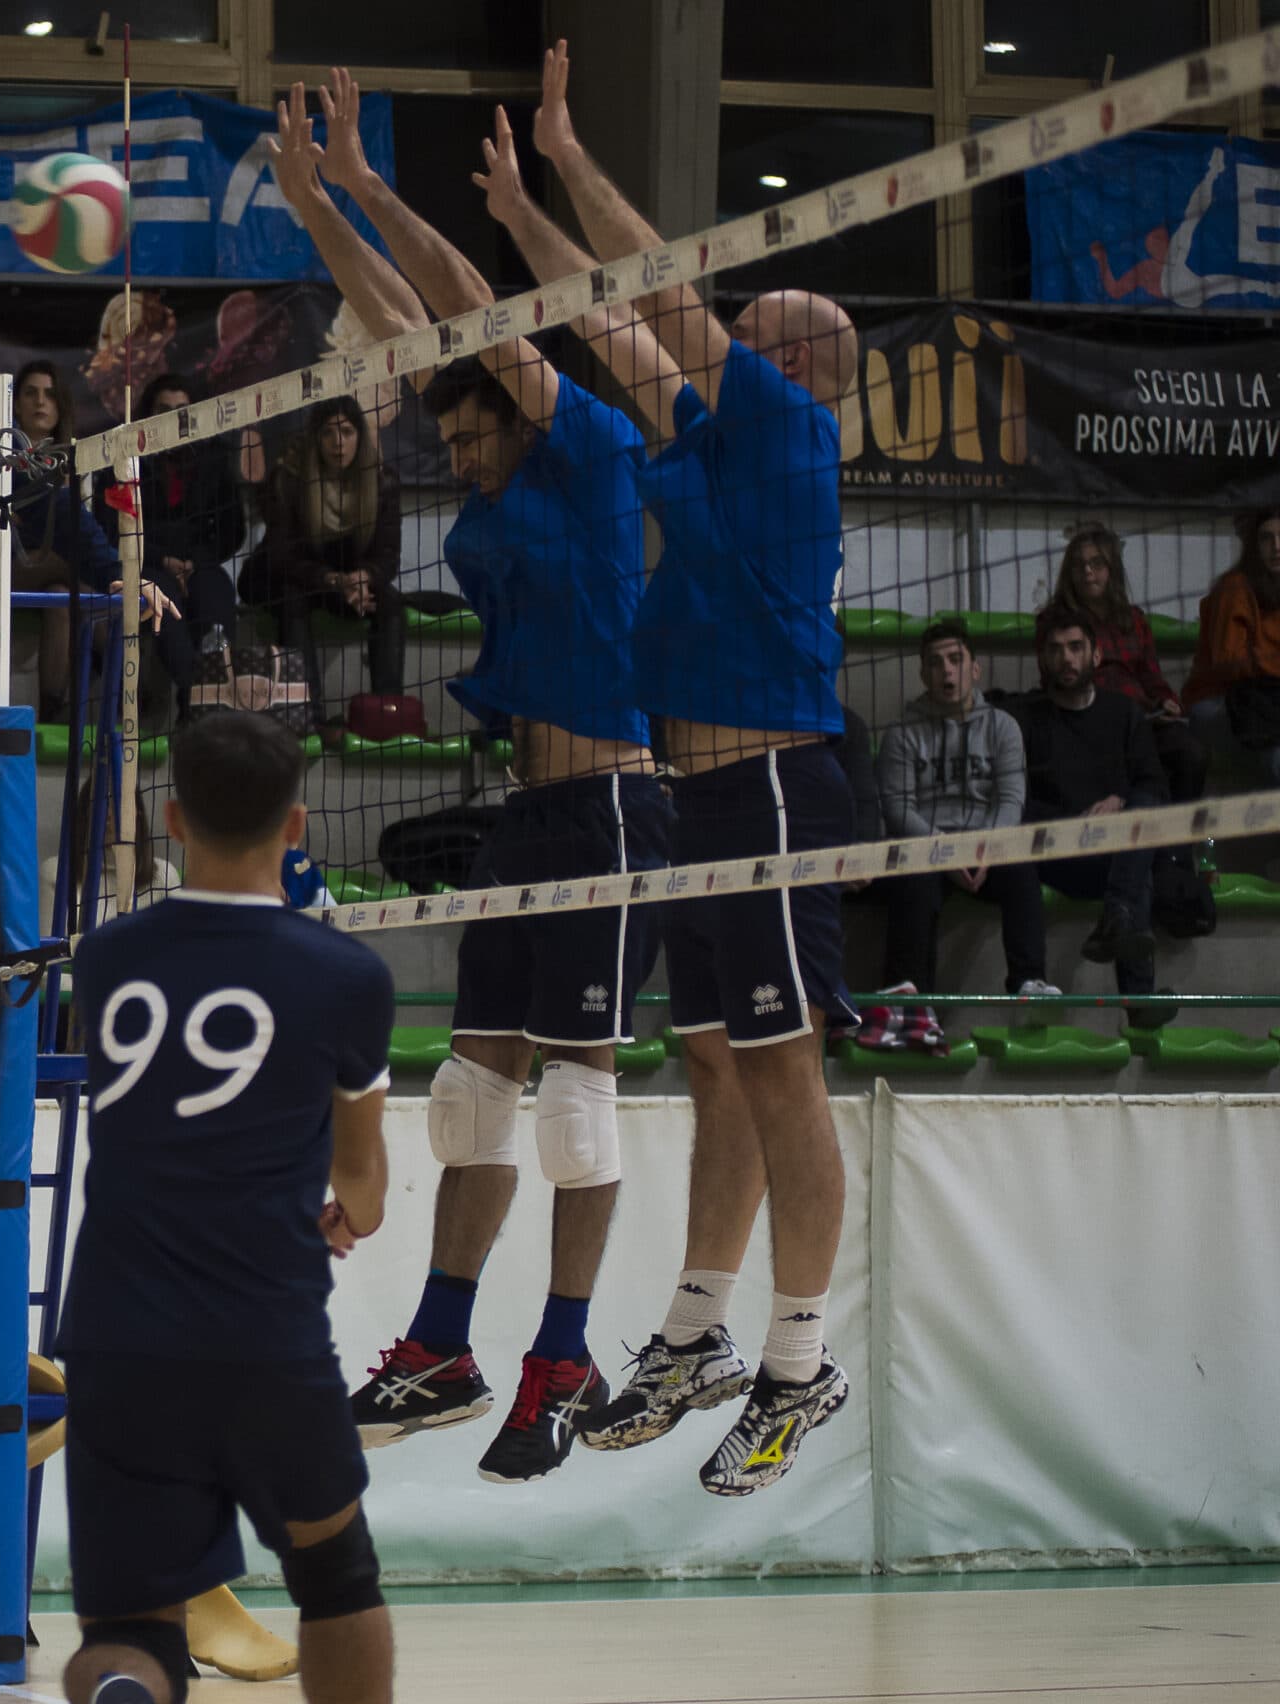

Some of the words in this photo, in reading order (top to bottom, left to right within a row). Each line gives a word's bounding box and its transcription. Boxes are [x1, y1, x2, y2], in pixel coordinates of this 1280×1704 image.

[1134, 368, 1225, 407] SCEGLI
[1235, 372, 1271, 408] LA
[1075, 413, 1217, 457] PROSSIMA
[843, 469, 893, 485] REAM
[901, 472, 1005, 488] ADVENTURE
[94, 979, 276, 1118] 99
